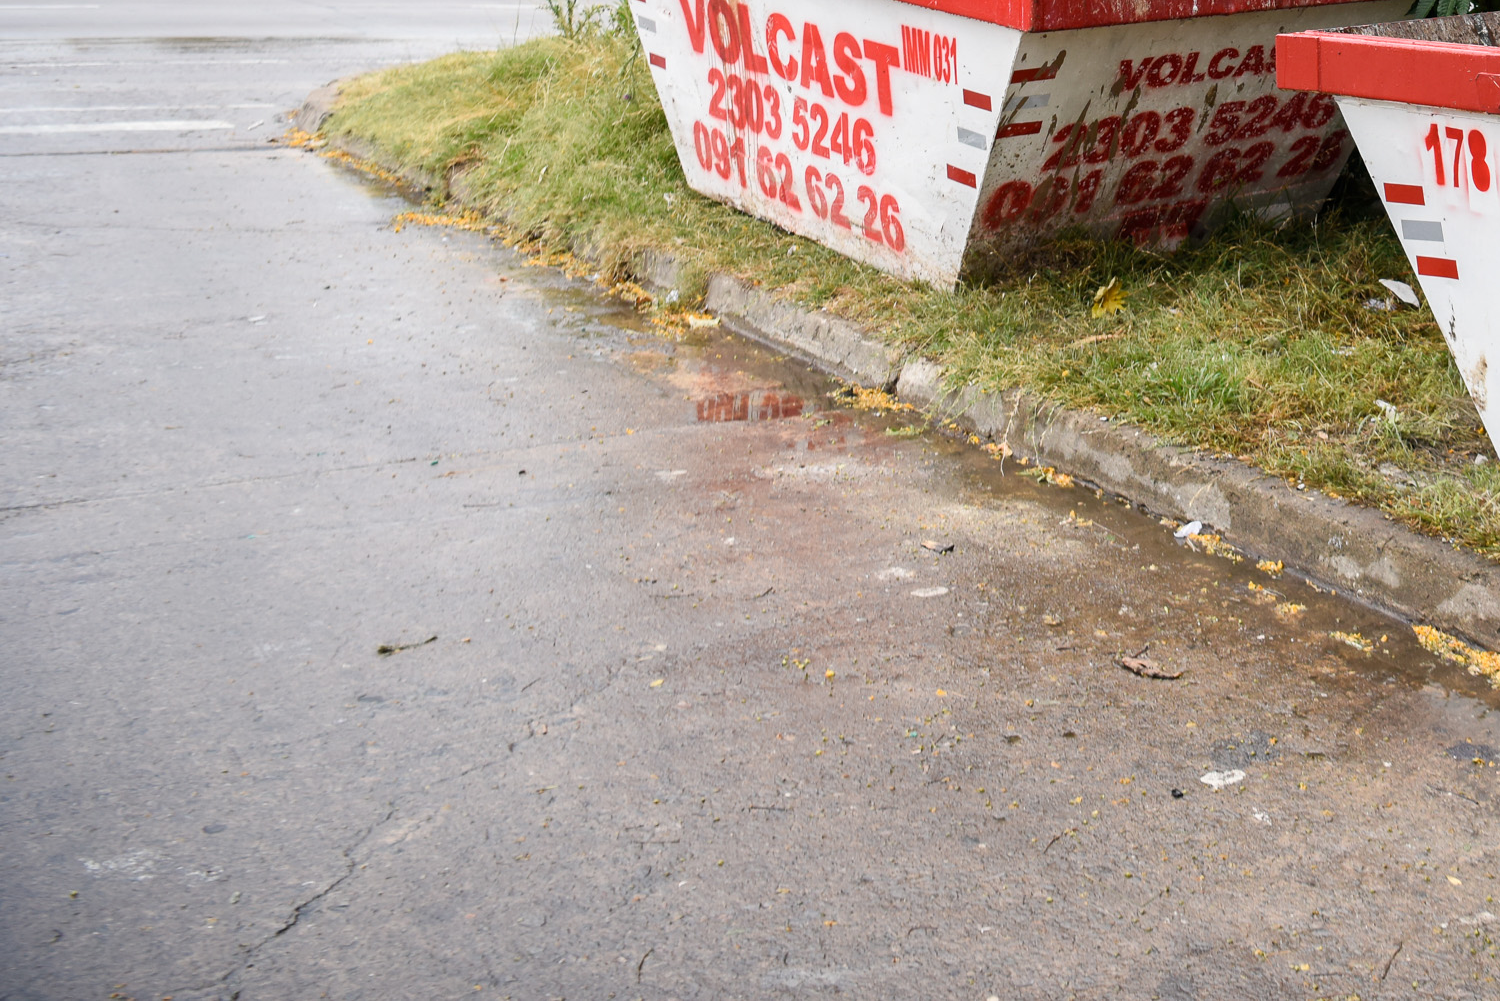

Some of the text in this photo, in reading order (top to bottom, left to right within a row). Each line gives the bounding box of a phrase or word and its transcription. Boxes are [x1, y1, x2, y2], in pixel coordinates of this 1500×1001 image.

[901, 24, 958, 85] IMM 031
[707, 67, 876, 177] 2303 5246
[1203, 91, 1336, 147] 5246
[694, 120, 905, 252] 091 62 62 26
[1114, 155, 1194, 207] 62
[1424, 122, 1491, 193] 178
